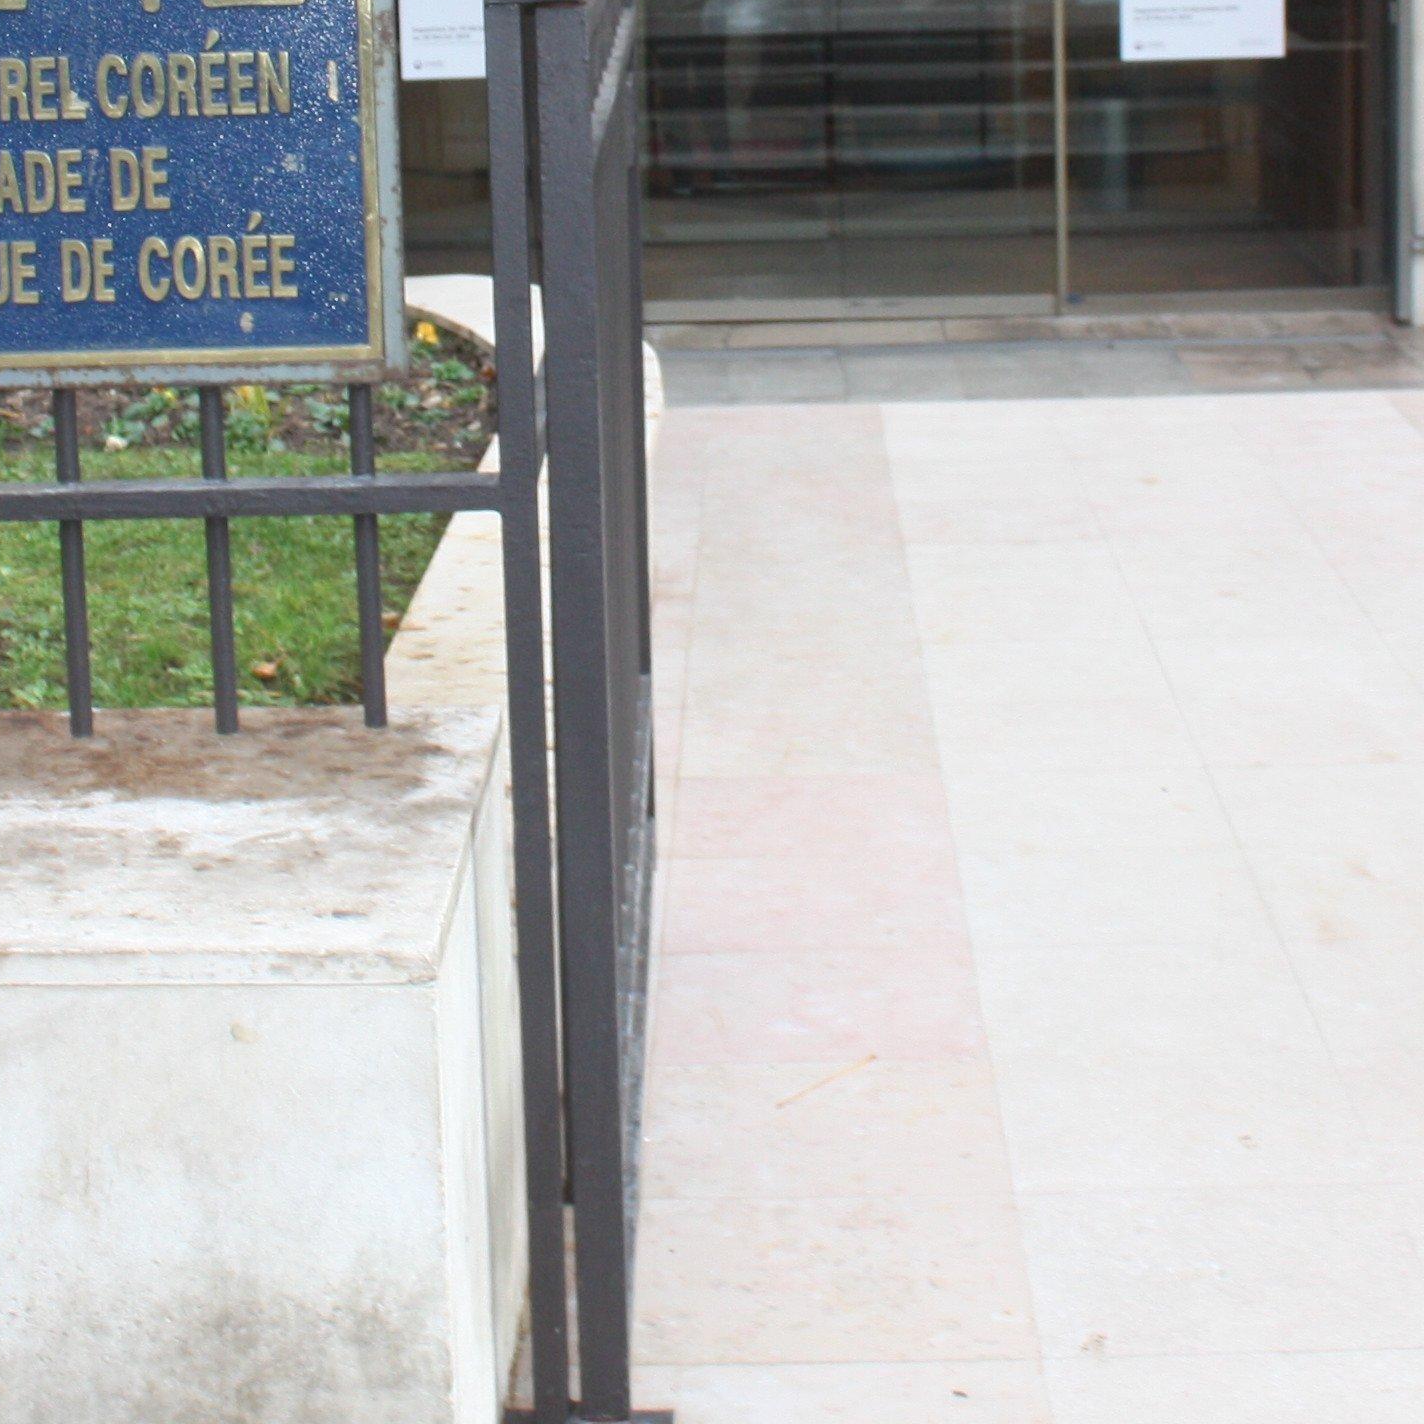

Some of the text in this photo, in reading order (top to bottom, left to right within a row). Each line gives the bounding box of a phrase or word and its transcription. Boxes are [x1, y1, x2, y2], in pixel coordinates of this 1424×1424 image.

[96, 30, 292, 120] CORÉEN
[111, 147, 172, 212] DE
[61, 239, 117, 304] DE
[139, 212, 300, 302] CORÉE
